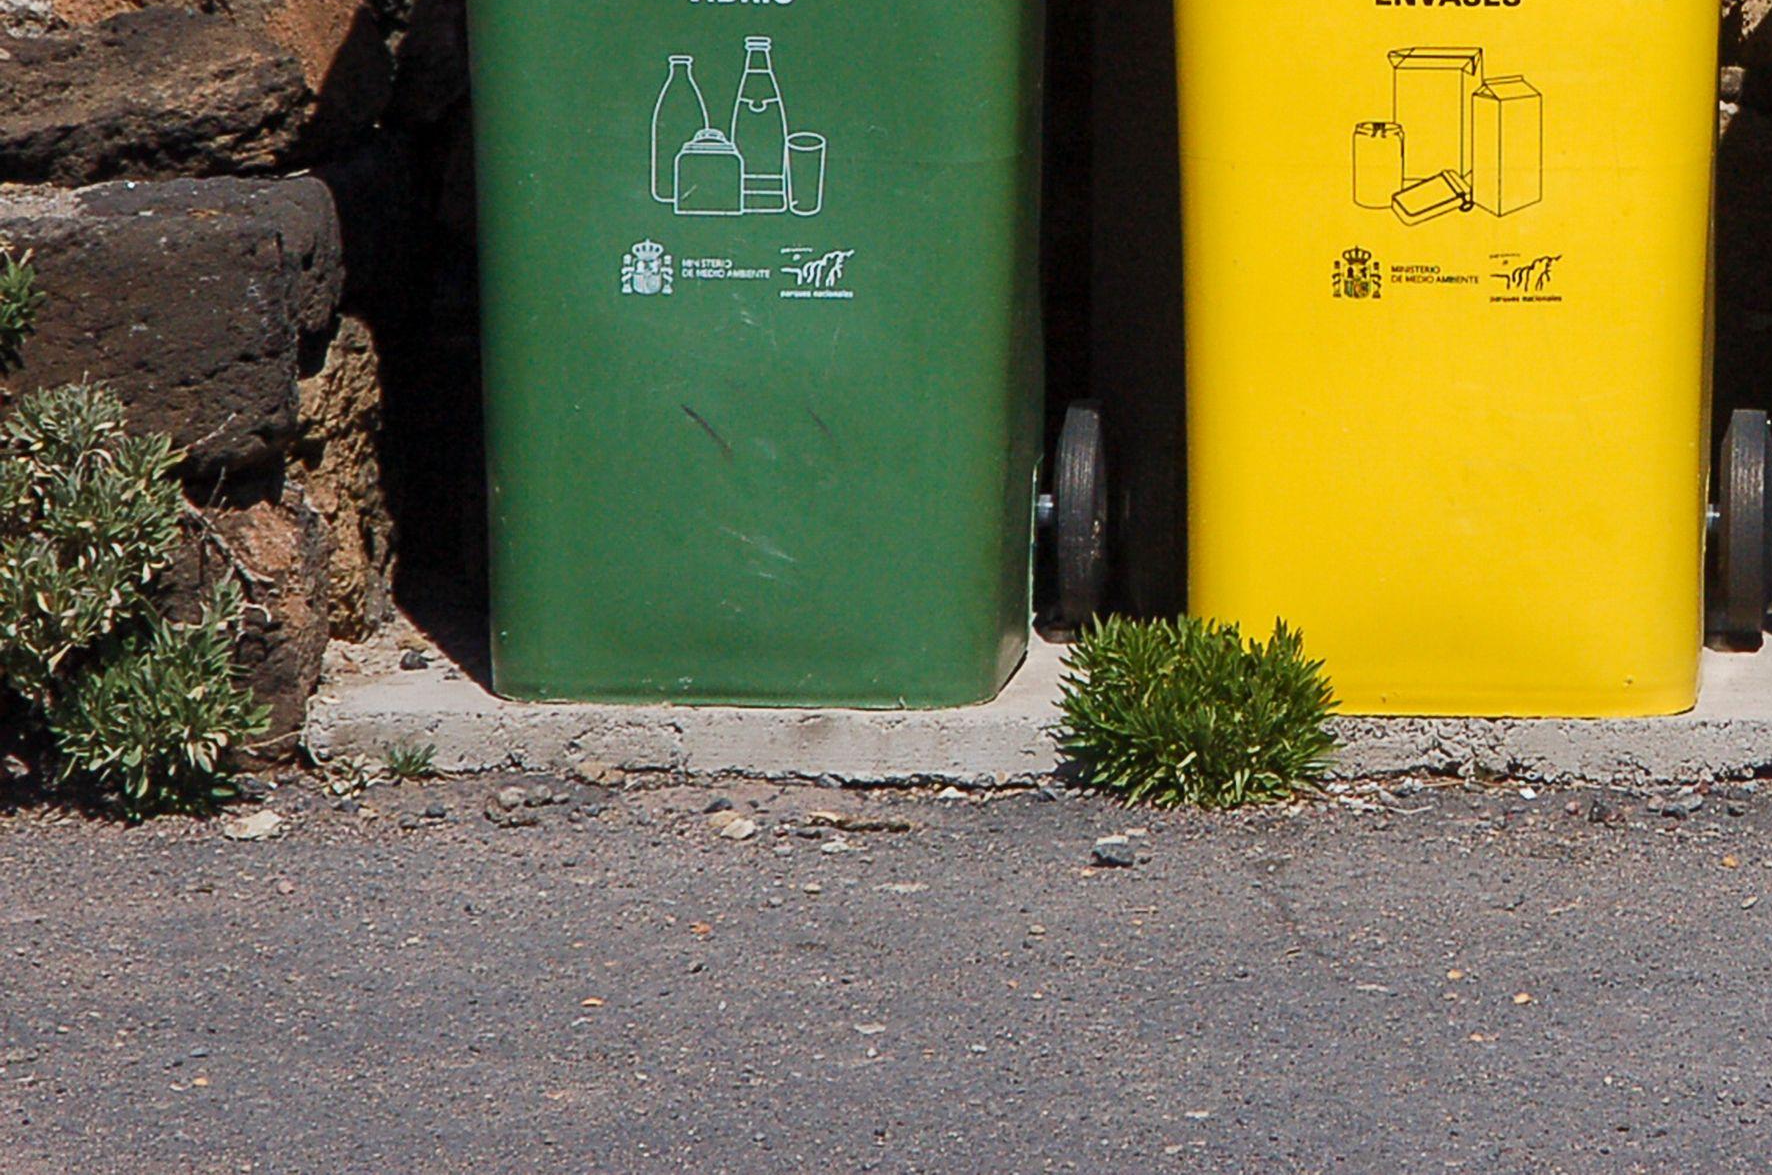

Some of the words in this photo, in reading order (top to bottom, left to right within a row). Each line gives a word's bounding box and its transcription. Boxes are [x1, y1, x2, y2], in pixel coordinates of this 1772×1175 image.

[681, 268, 694, 279] DE
[695, 268, 726, 279] MEDIO
[1390, 265, 1441, 275] MINISTERIO
[1390, 274, 1403, 284] DE
[1405, 274, 1435, 284] MEDIO
[1435, 275, 1479, 284] AMBIENTE
